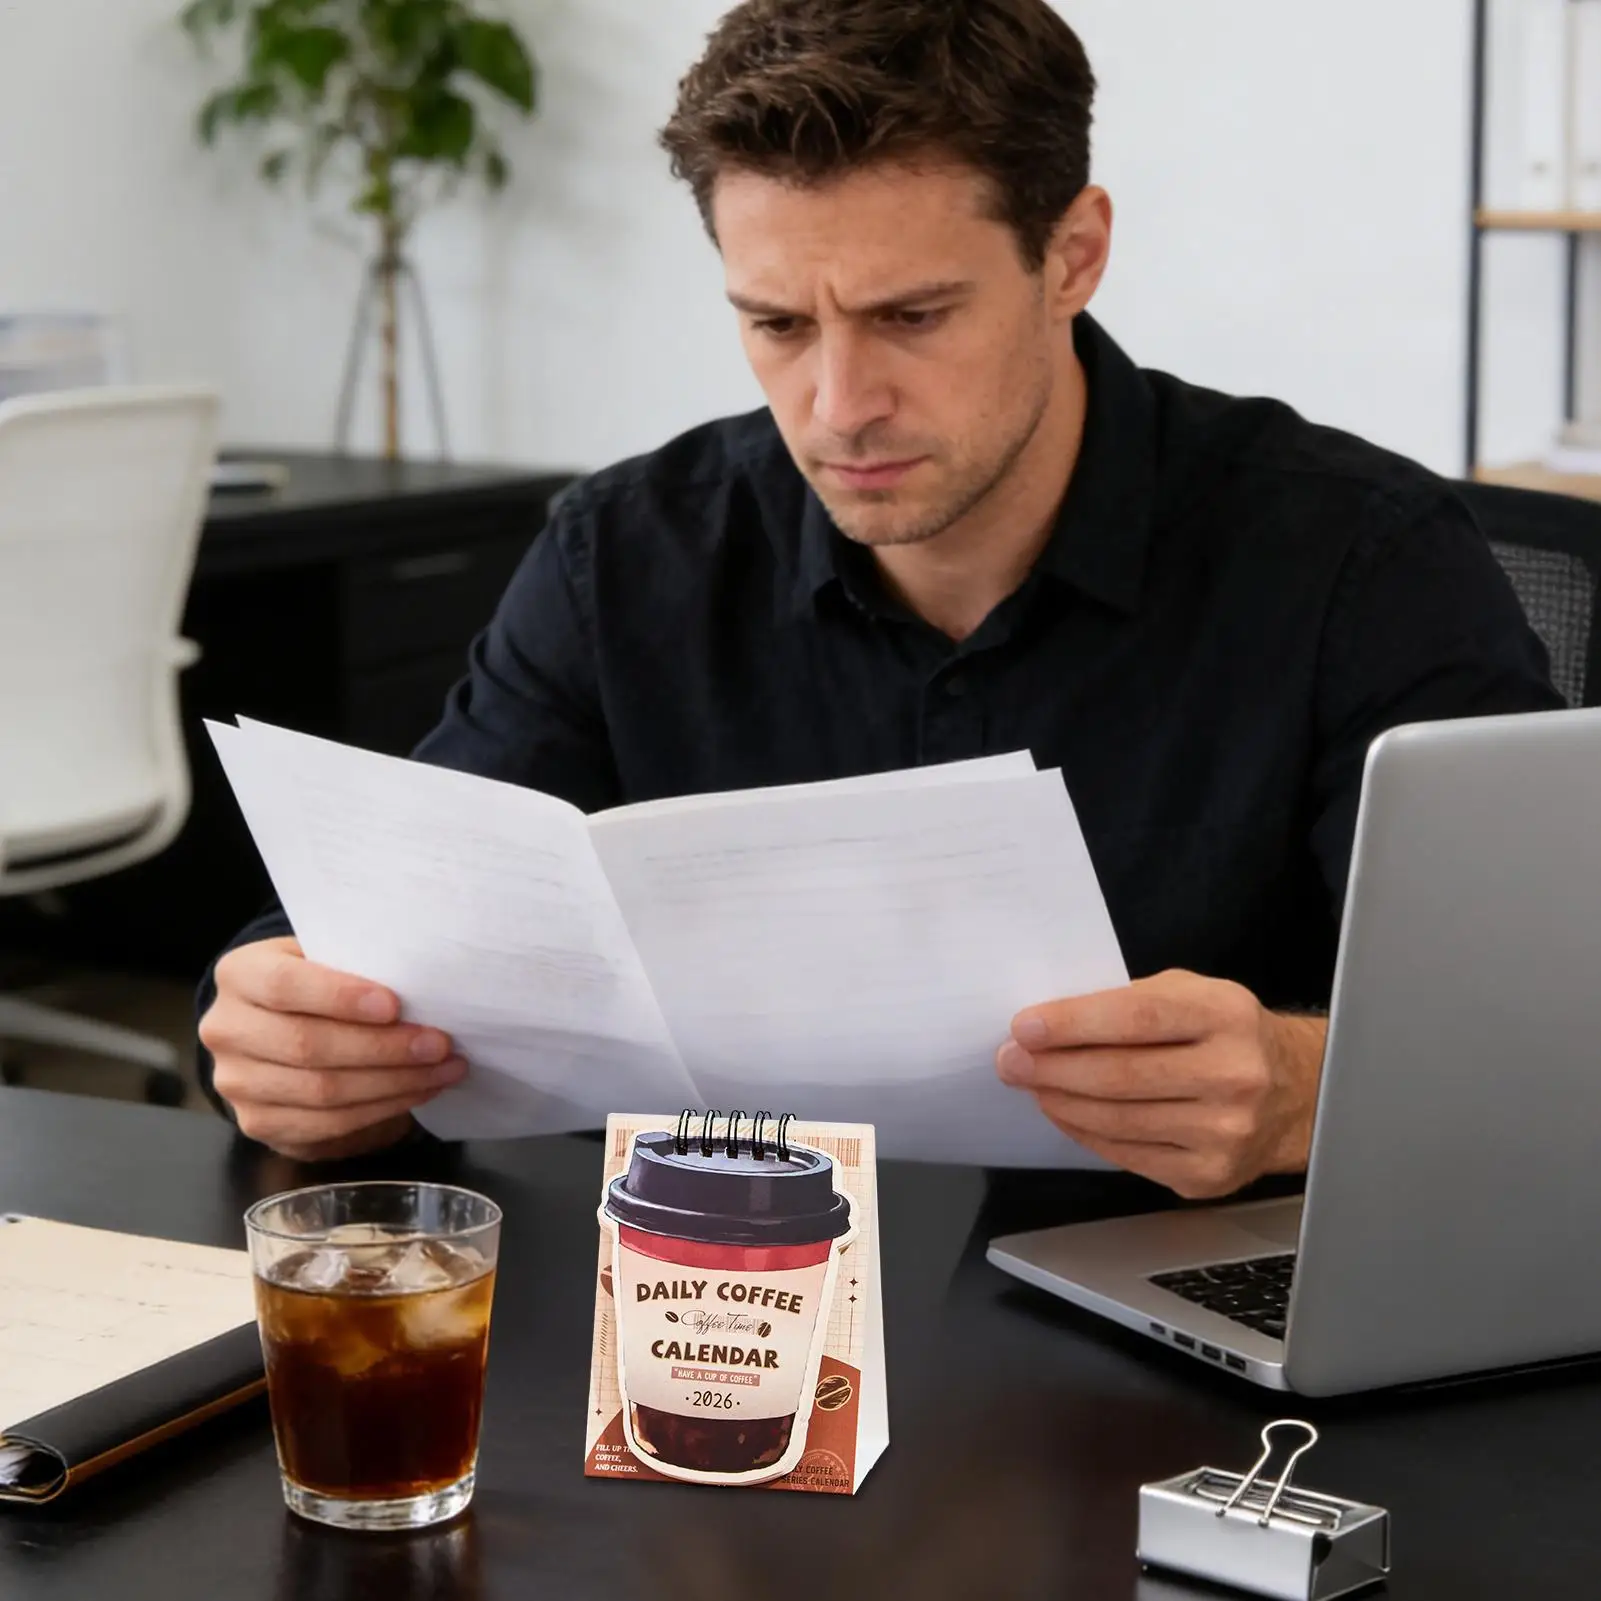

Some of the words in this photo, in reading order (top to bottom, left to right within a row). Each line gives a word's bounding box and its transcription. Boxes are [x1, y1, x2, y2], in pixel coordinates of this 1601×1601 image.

[636, 1280, 708, 1303] DAILY
[716, 1282, 804, 1314] COFFEE
[681, 1310, 724, 1335] Coffee
[727, 1312, 753, 1331] Time
[651, 1340, 780, 1369] CALENDAR
[697, 1372, 702, 1380] A
[704, 1372, 717, 1381] CUP
[720, 1374, 728, 1382] OF
[595, 1444, 611, 1452] FILL
[612, 1445, 622, 1453] UP
[595, 1453, 622, 1463] COFFEE,
[594, 1463, 610, 1471] AND
[610, 1465, 639, 1473] CHEERS.
[806, 1466, 834, 1476] COFFEE
[810, 1476, 850, 1488] CALENDAR
